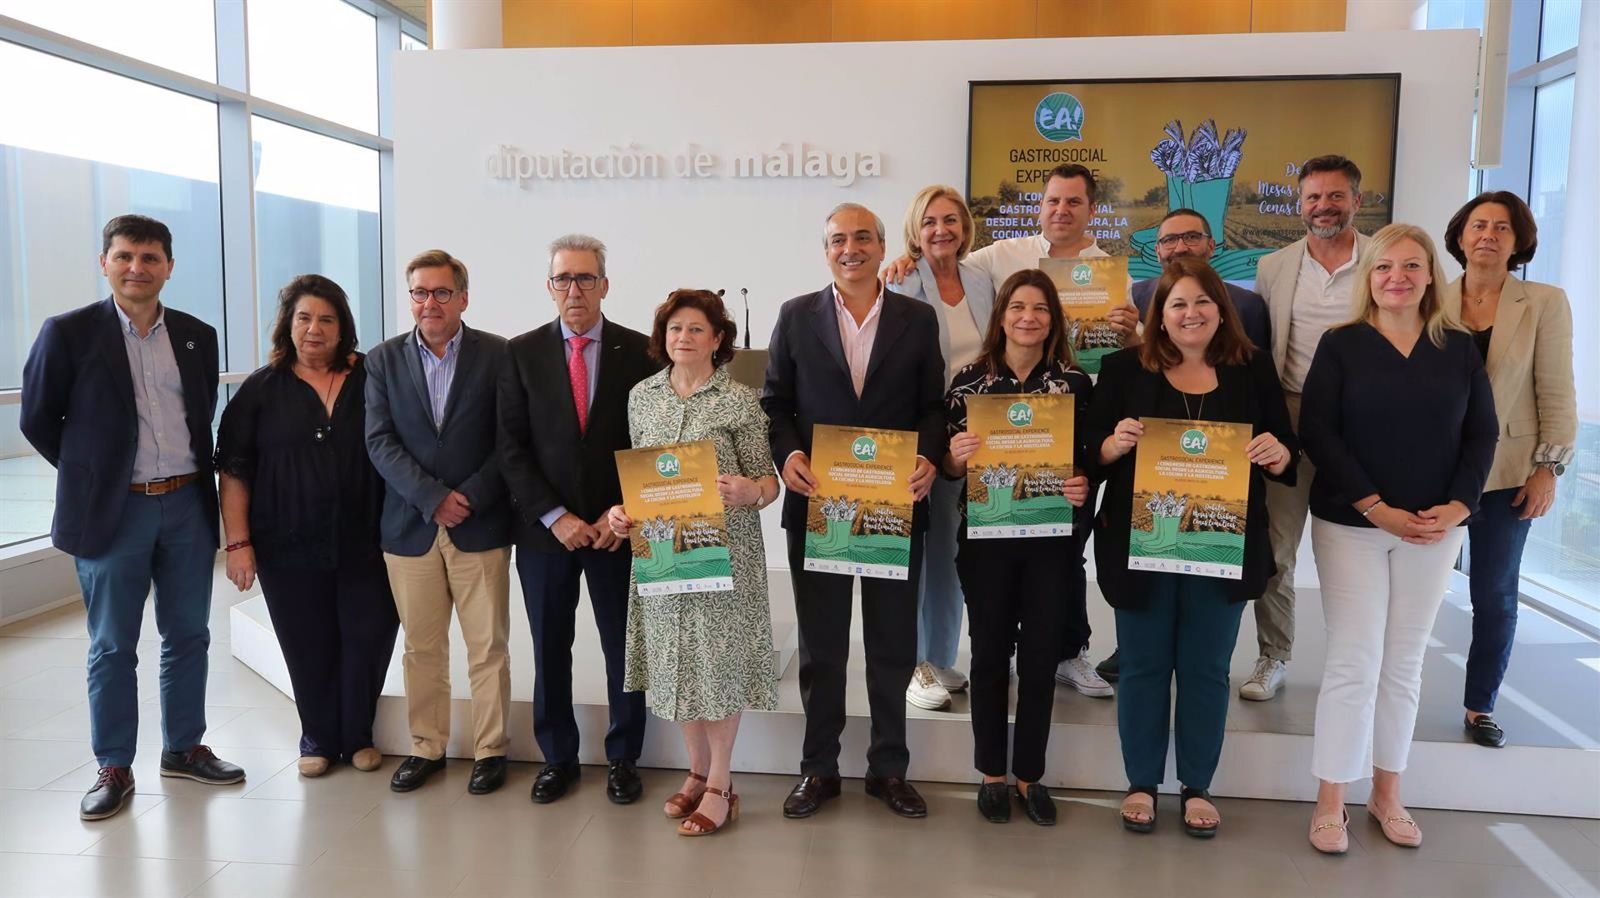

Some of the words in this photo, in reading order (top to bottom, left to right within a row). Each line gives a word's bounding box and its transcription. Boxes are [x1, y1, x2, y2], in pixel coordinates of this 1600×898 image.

[1040, 105, 1081, 130] EA!
[1009, 148, 1107, 163] GASTROSOCIAL
[487, 143, 658, 187] diputación
[672, 143, 713, 177] de
[727, 143, 881, 187] málaga
[1258, 180, 1293, 196] Mesas
[999, 204, 1041, 215] GASTRO
[1259, 200, 1293, 216] Cenas
[986, 217, 1018, 227] DESDE
[1021, 217, 1033, 227] LA
[1114, 217, 1129, 227] LA
[992, 230, 1029, 239] COCINA
[1072, 270, 1092, 281] EA!
[1010, 409, 1031, 421] EA!
[854, 443, 875, 456] EA!
[1182, 437, 1205, 450] EA!
[658, 459, 678, 472] EA!
